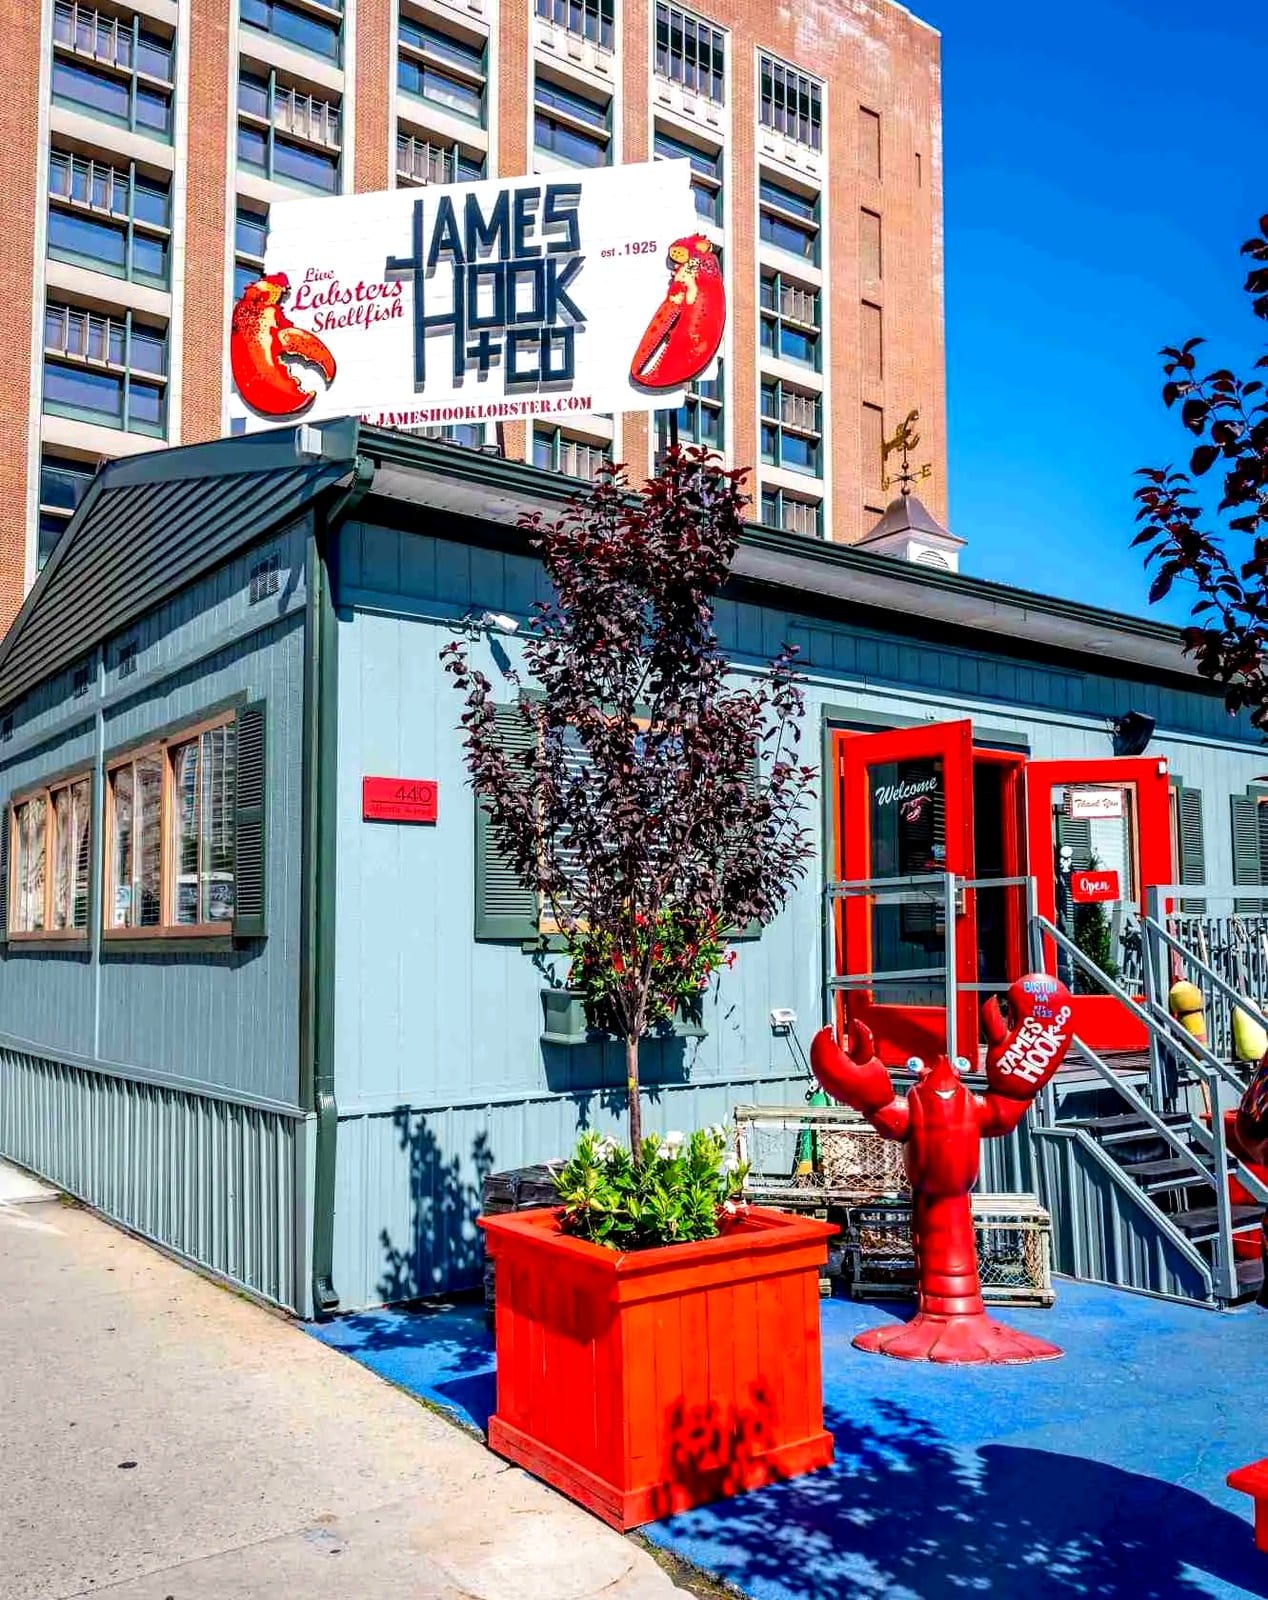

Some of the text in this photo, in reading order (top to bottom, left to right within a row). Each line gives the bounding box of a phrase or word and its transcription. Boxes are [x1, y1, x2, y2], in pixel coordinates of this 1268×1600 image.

[386, 183, 582, 268] JAMES
[625, 240, 657, 256] 1925
[303, 267, 334, 283] Live
[290, 279, 403, 312] Lobsters
[312, 298, 405, 334] Shellfish
[413, 256, 588, 383] HOOK
[394, 785, 432, 803] 440
[875, 776, 938, 806] Welcome
[1080, 878, 1111, 896] Open
[996, 1016, 1043, 1076] JAMES
[1013, 1025, 1067, 1084] HOOK
